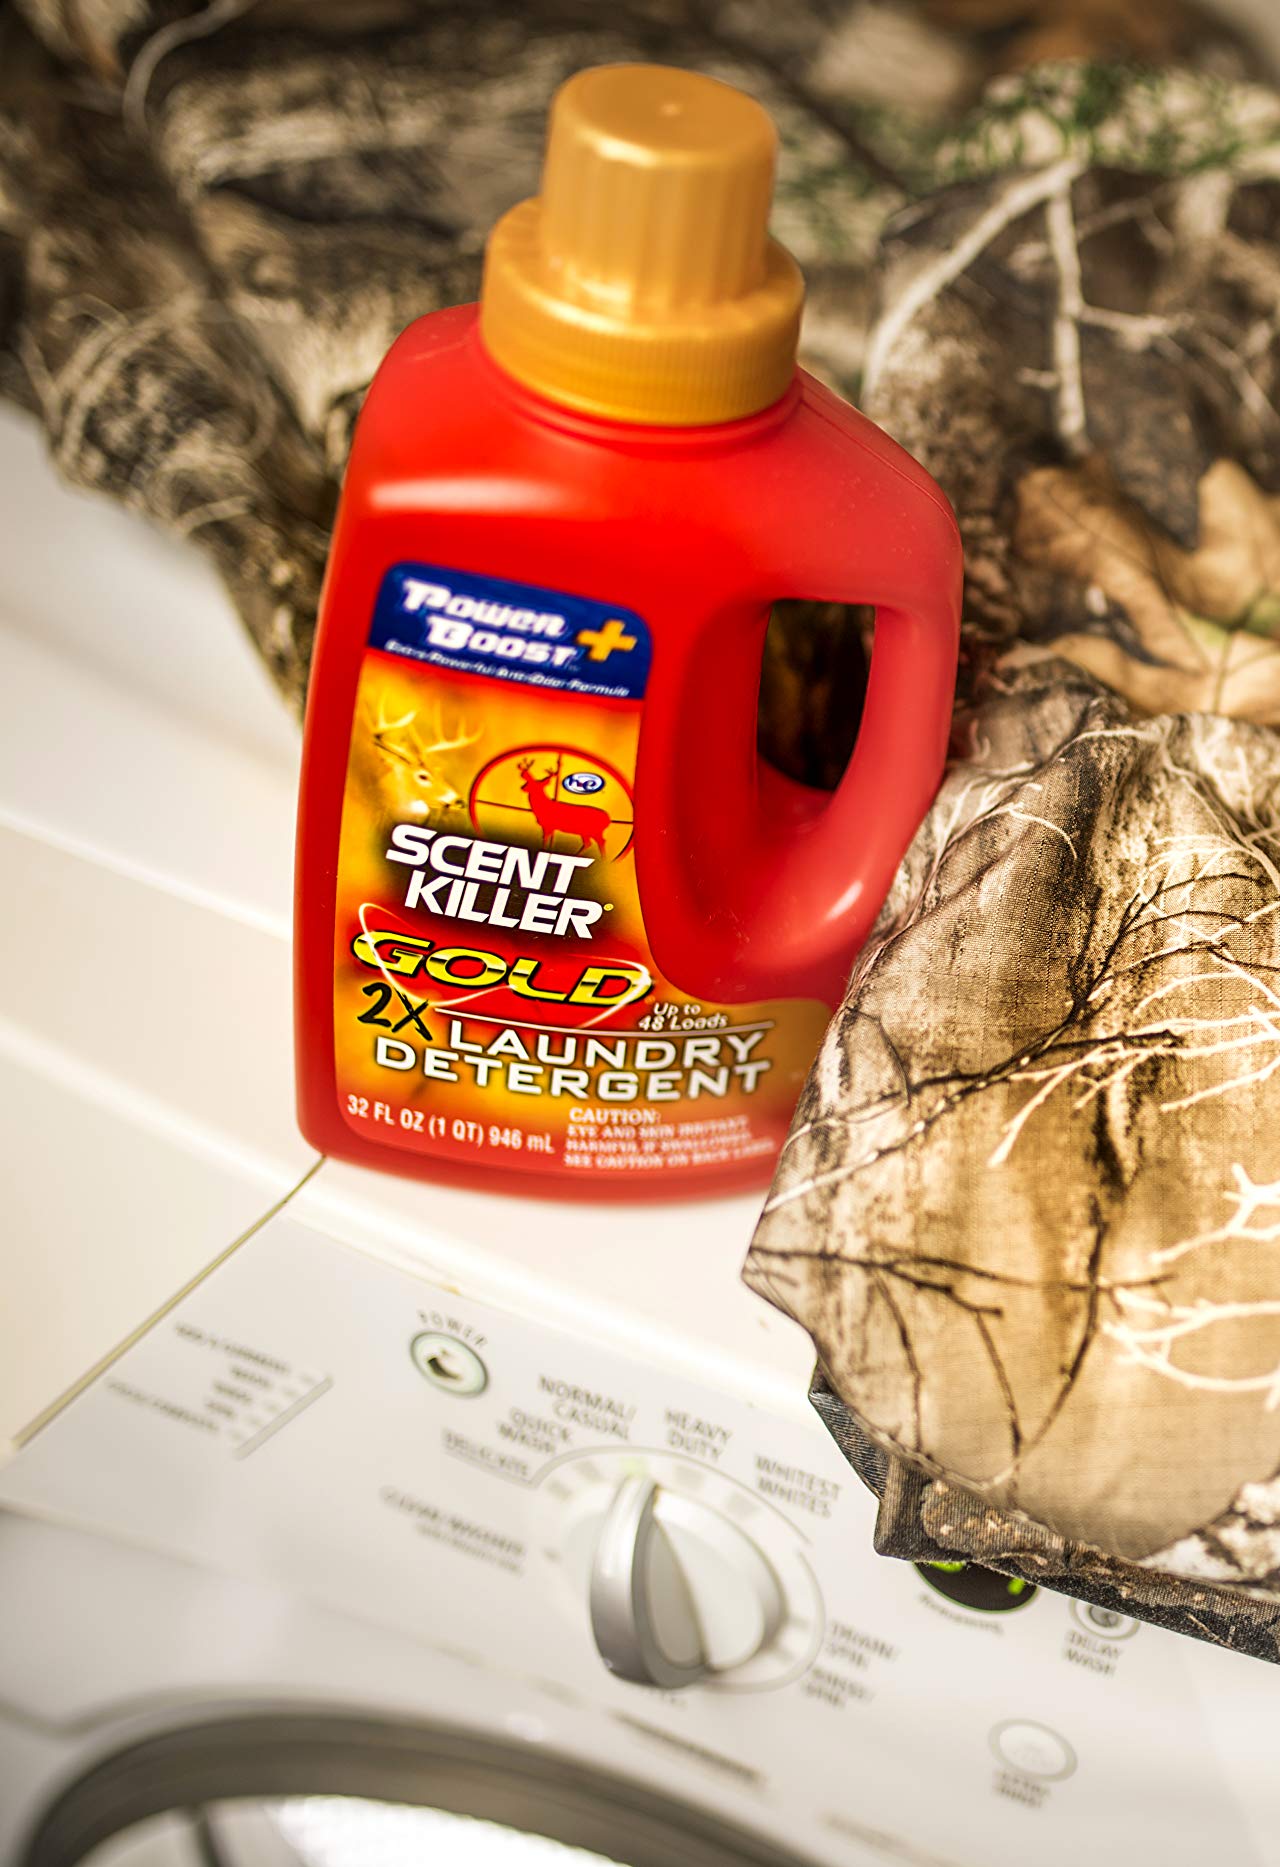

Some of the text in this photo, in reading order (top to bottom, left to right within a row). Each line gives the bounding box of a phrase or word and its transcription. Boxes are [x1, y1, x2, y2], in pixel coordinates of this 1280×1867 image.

[385, 823, 596, 894] SCENT
[404, 869, 604, 940] KILLER
[351, 929, 655, 1007] GOLD
[357, 982, 433, 1042] 2X
[638, 1012, 729, 1032] 48 Loads
[653, 1002, 701, 1019] Up to
[376, 1035, 771, 1101] DETERGENT
[449, 1019, 765, 1070] LAUNDRY
[346, 1093, 370, 1119] 32
[373, 1101, 396, 1126] FL
[400, 1107, 426, 1133] OZ
[428, 1114, 446, 1139] (1
[488, 1125, 523, 1150] 946
[527, 1132, 556, 1154] mL
